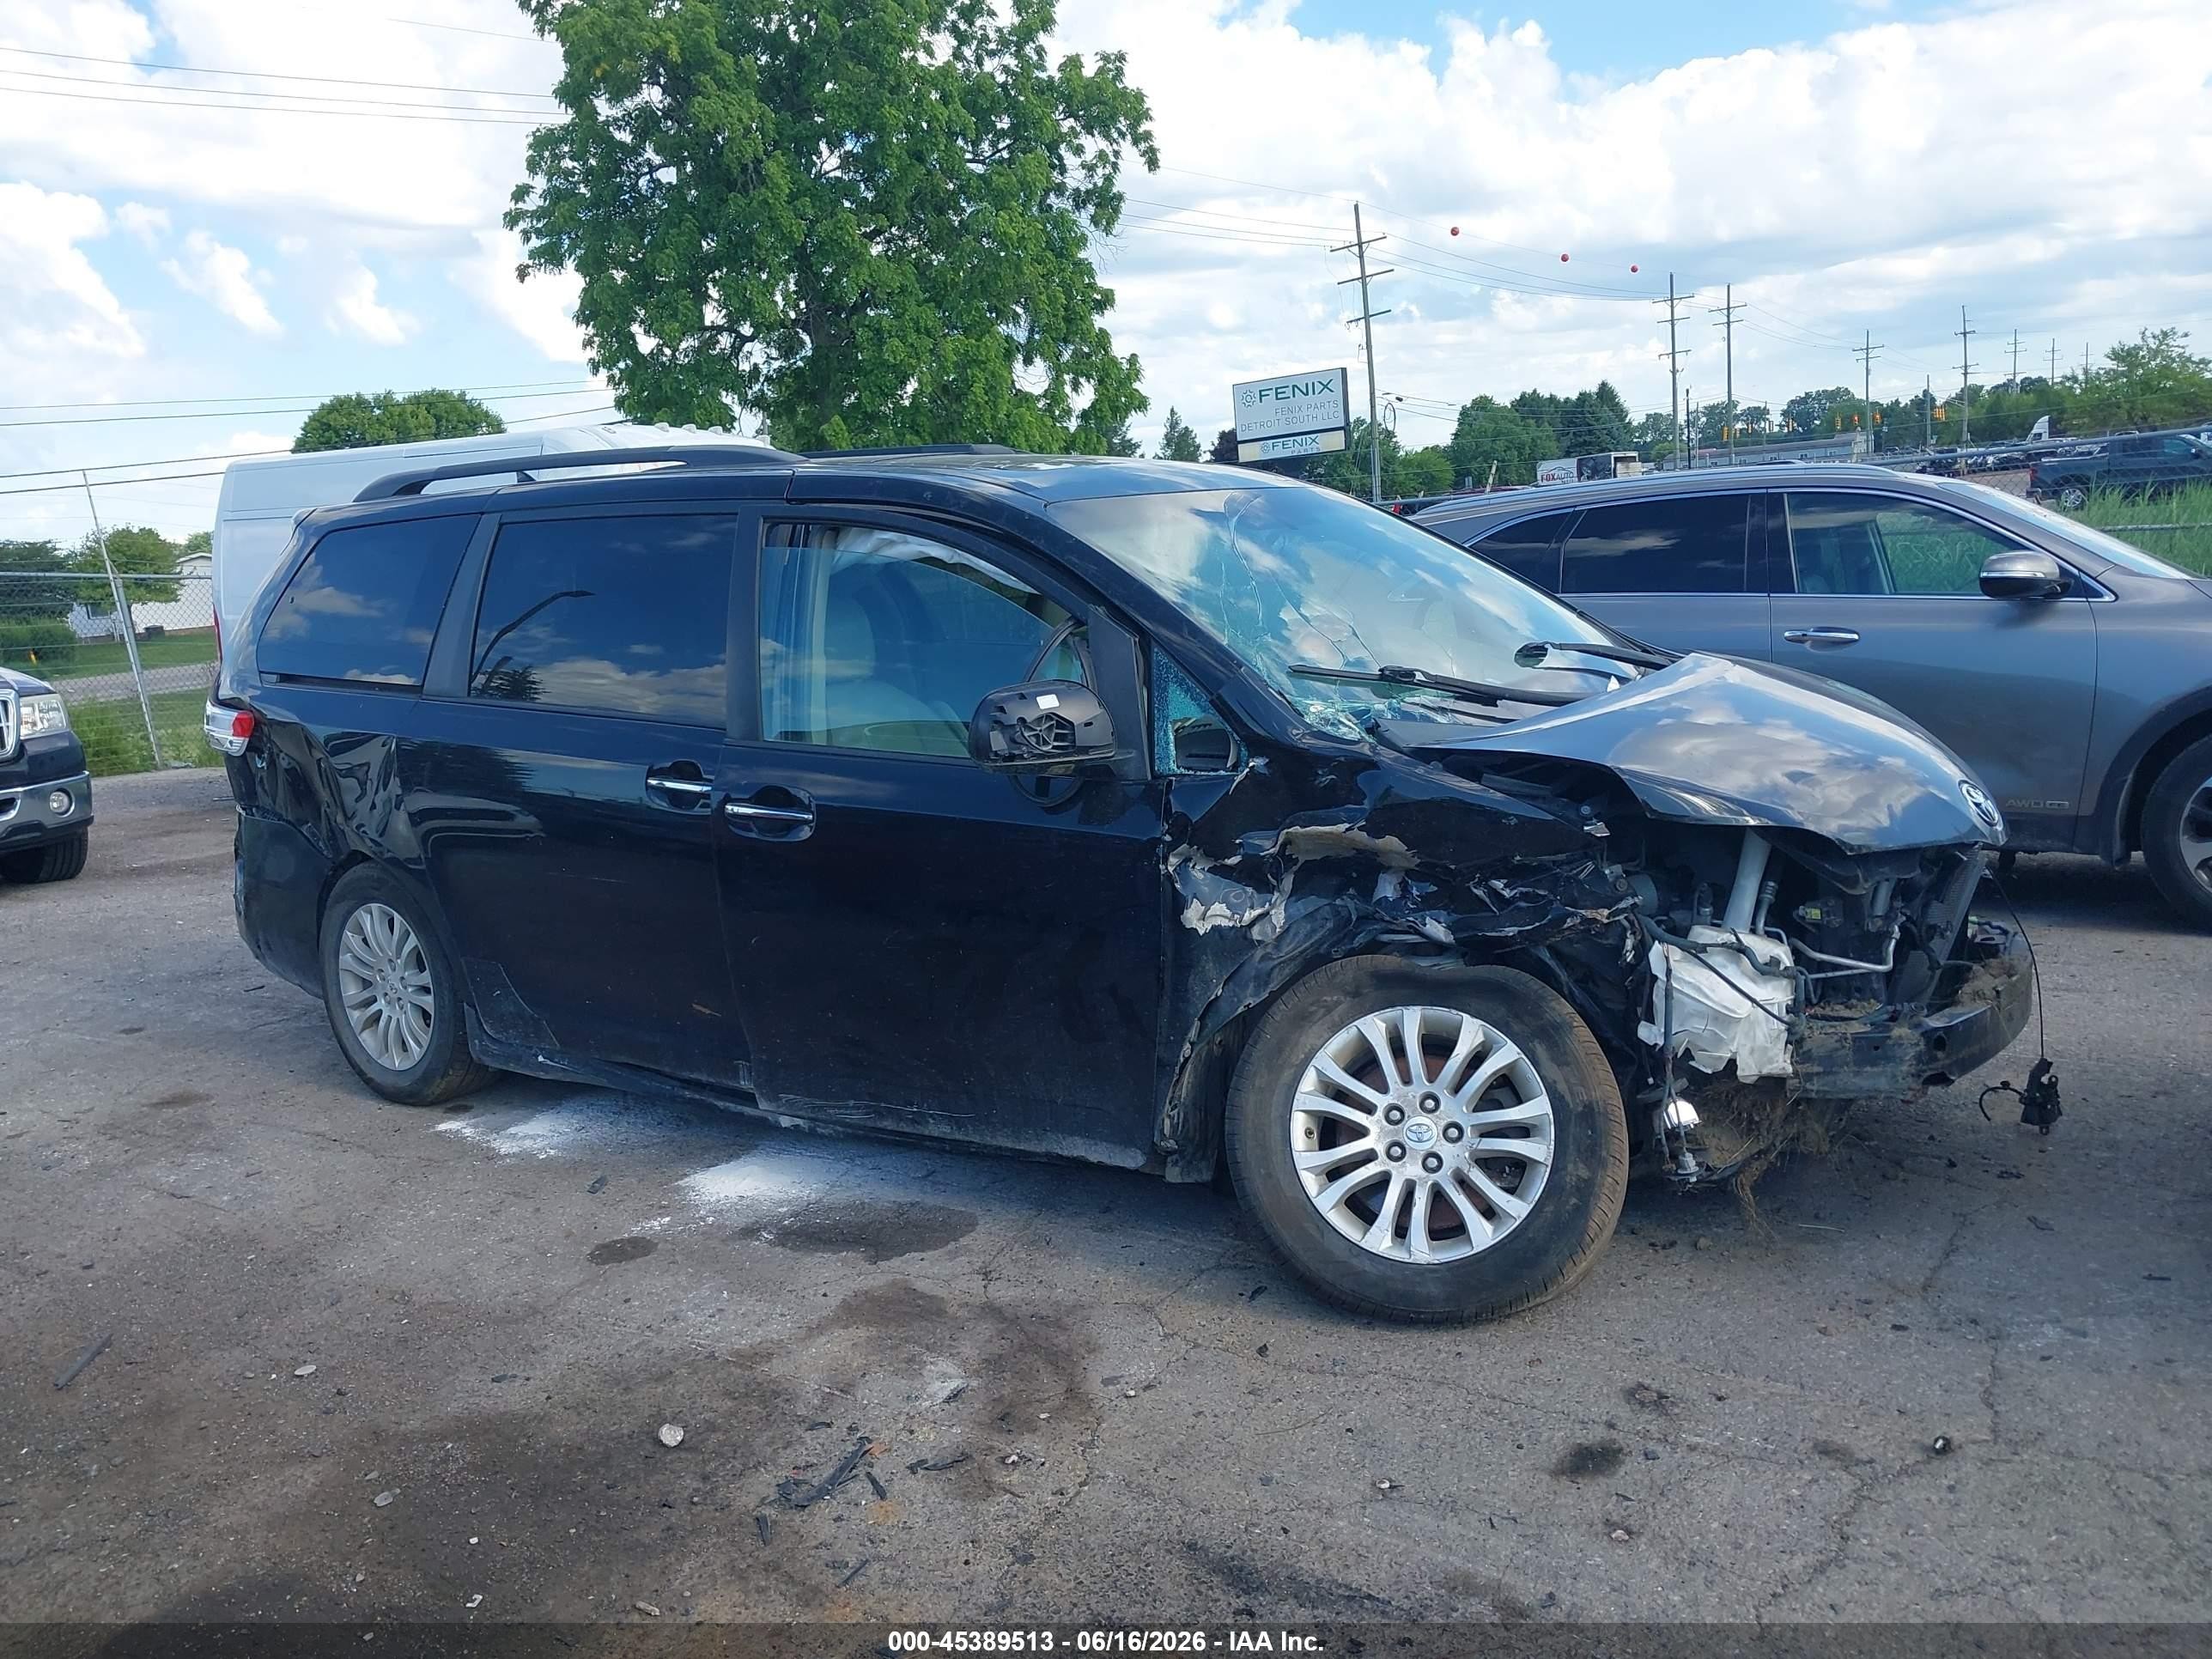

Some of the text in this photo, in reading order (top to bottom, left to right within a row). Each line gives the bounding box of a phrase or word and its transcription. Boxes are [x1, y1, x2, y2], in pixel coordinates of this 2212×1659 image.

[1259, 379, 1334, 404] FENIX
[1275, 400, 1339, 416] FENIX PARTS
[1241, 410, 1340, 432] DETROIT SOUTH LLC
[1272, 435, 1319, 451] FENIX
[1291, 447, 1320, 455] PARTS
[2005, 799, 2044, 809] AWD
